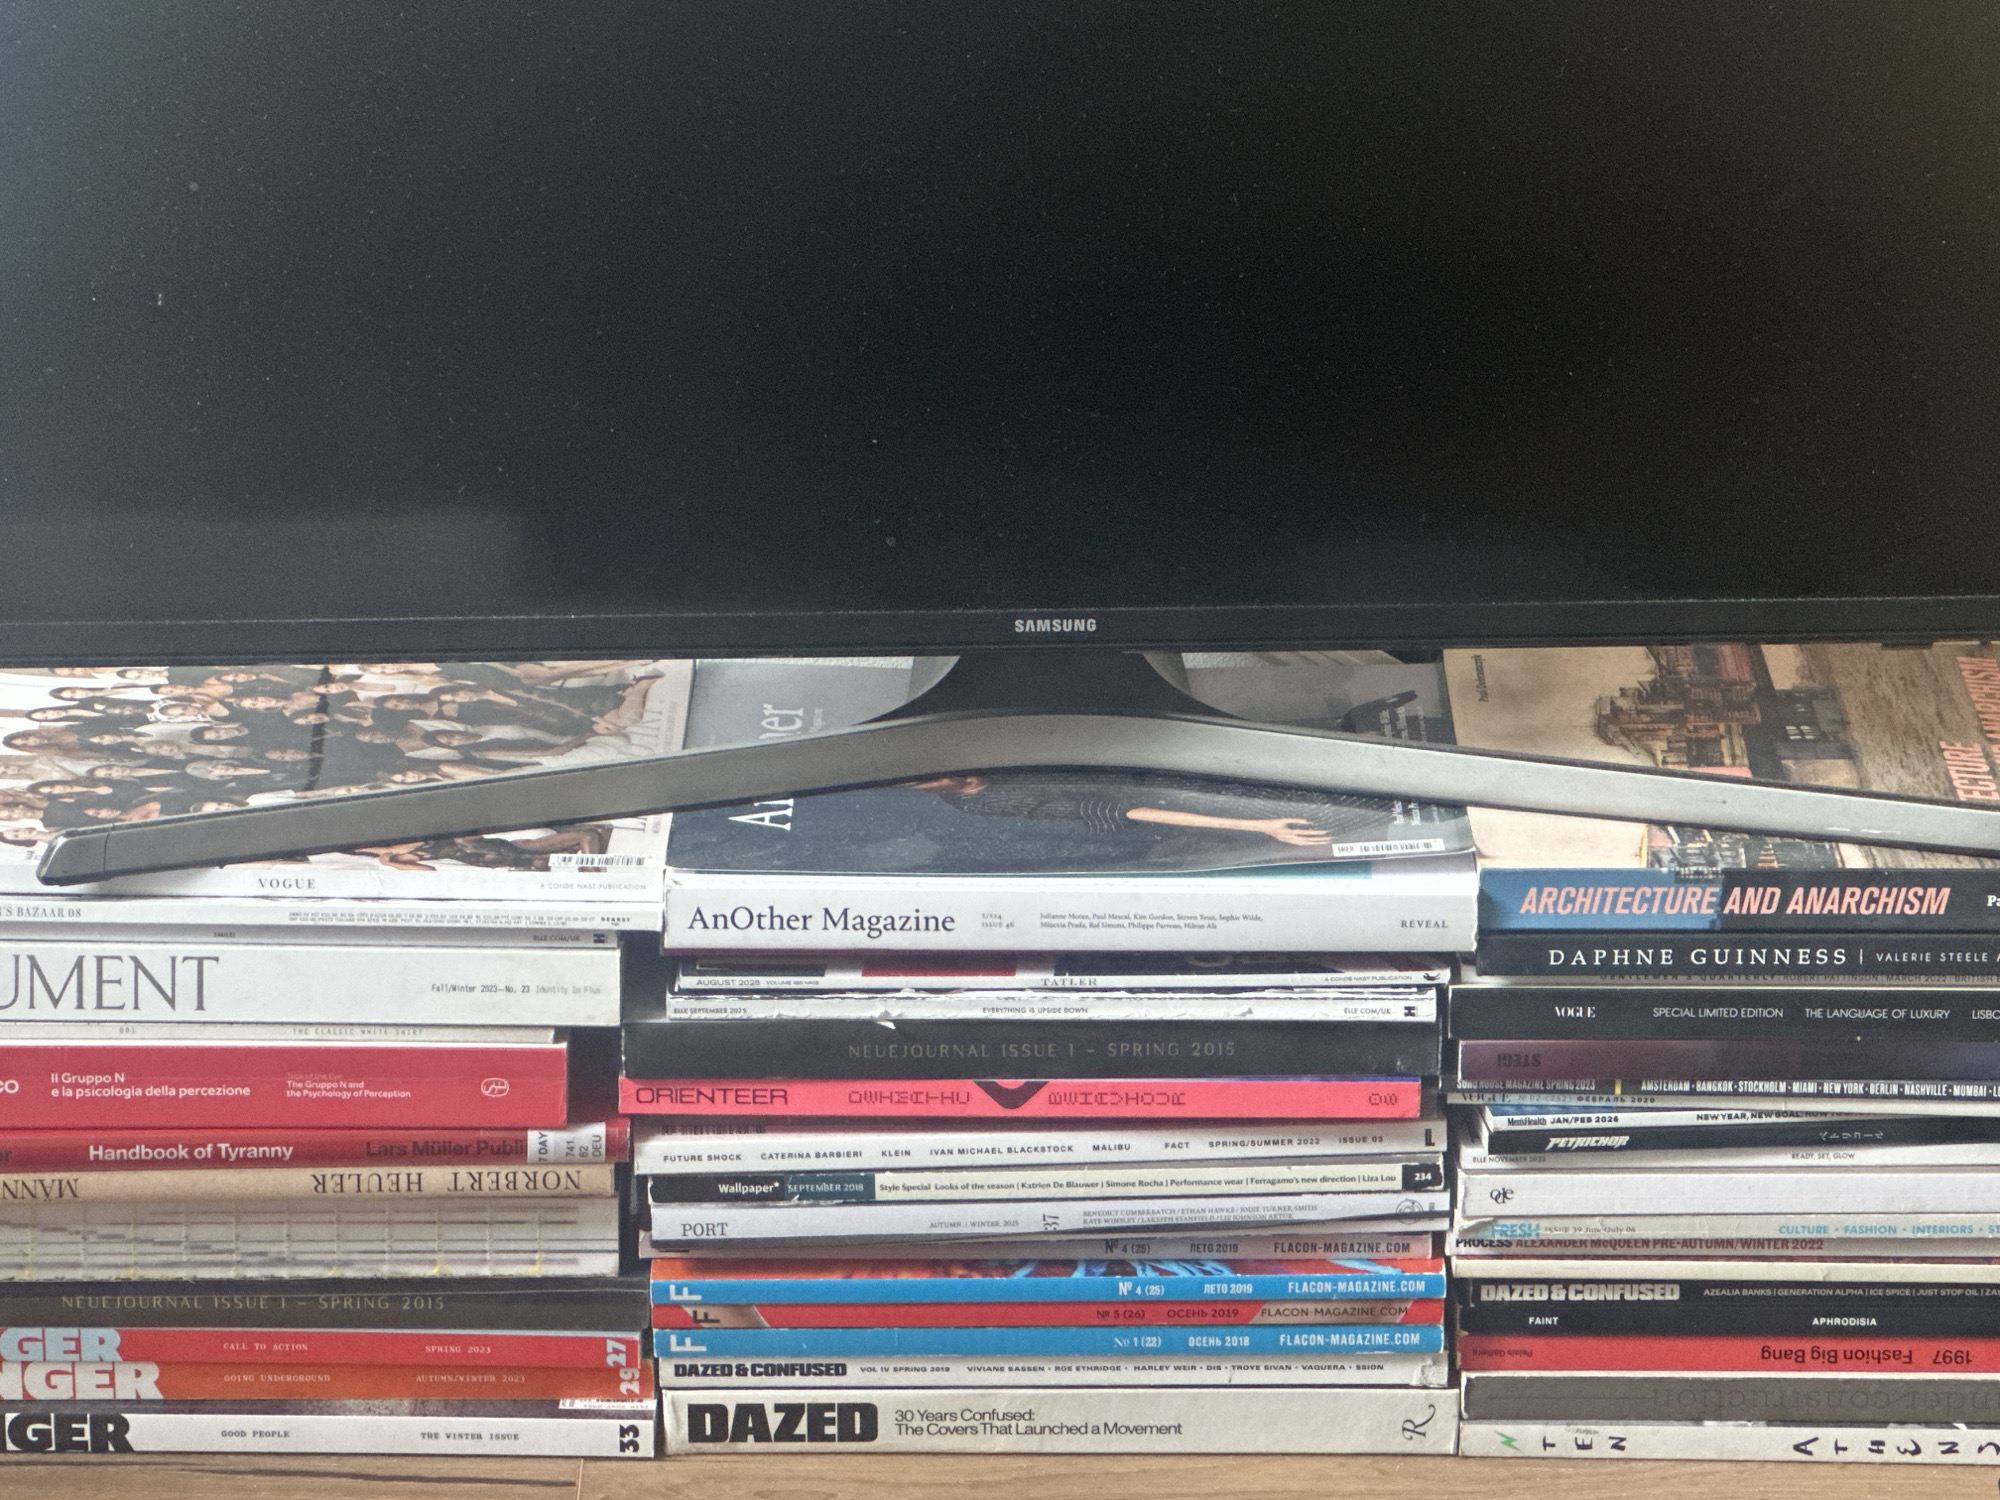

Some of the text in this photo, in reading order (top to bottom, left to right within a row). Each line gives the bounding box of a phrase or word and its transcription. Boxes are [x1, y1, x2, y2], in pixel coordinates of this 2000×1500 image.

[1014, 618, 1097, 633] SAMSUNG
[258, 878, 316, 890] VOGUE
[1519, 886, 1951, 915] ARCHITECTURE AND ANARCHISM
[17, 906, 64, 918] BAZAAR
[688, 905, 956, 939] AnOther Magazine
[1401, 920, 1448, 929] REVEAL
[1548, 949, 1988, 966] DAPHNE GUINNESS VALERIE STEELE
[431, 984, 476, 994] Fall/Winter
[1041, 978, 1098, 986] TATLER
[1554, 1006, 1950, 1019] VOGUE SPECIAL LIMITED EDITION THE LANGUAGE OF LUXURY
[1002, 1042, 1236, 1057] ISSUE SPRING 2015
[61, 1073, 112, 1086] Gruppo
[305, 1080, 364, 1090] Gruppo and
[1575, 1079, 1595, 1090] 2023
[76, 1085, 251, 1099] psicologia della percezione
[303, 1089, 411, 1099] Psychology Perception
[636, 1086, 788, 1105] ORIENTEER
[1641, 1081, 1987, 1097] AMSTERDAM BANGKOK STOCKHOLM MIAMI NEW YORK BERLIN NASHVILLE MUMBAI
[1550, 1115, 1618, 1125] JAN/FEB 2026
[365, 1140, 407, 1157] Lars
[538, 1132, 547, 1155] DAY
[592, 1135, 601, 1158] DEU
[707, 1153, 742, 1162] SHOCK
[760, 1152, 811, 1160] CATERINA
[815, 1151, 862, 1159] BARBIERI
[957, 1147, 1003, 1155] MICHAEL
[1007, 1145, 1074, 1154] BLACKSTOCK
[1209, 1138, 1293, 1148] SPRING/SUMMER
[1545, 1134, 1630, 1151] PETRICHOR
[89, 1143, 293, 1161] Handbook of Tyranny
[579, 1145, 588, 1158] 62
[1472, 1156, 1487, 1164] ELLE
[311, 1170, 582, 1194] NORBERT HEULER
[901, 1175, 1356, 1193] Special Performance direction
[1414, 1173, 1432, 1181] 234
[788, 1183, 841, 1193] SEPTEMBER
[681, 1221, 962, 1237] PORT AUTUMN
[1491, 1222, 1974, 1237] FRESH CULTURE FASHION INTERIORS
[1214, 1242, 1411, 1254] 2019 FLACON-MAGAZINE.COM
[1653, 1238, 1824, 1250] PRE-AUTUMN/WINTER 2022
[669, 1284, 702, 1301] F
[1145, 1280, 1425, 1297] (25) ЛЕТО 2019 FLACON-MAGAZINE.COM
[1480, 1283, 1680, 1301] DAZED & CONFUSED
[1703, 1288, 1864, 1296] AZEALIA BANKS GENERATION ALPHA
[214, 1296, 444, 1311] ISSUE SPRING 2015
[692, 1309, 720, 1324] F
[1167, 1308, 1239, 1319] ОСЕНЬ 2019
[1528, 1316, 1877, 1326] FAINT APHRODISIA
[273, 1343, 308, 1351] ACTION
[669, 1333, 707, 1352] F
[1188, 1333, 1420, 1347] ОСЕНЬ 2018 FLACON-MAGAZINE.COM
[606, 1339, 627, 1367] 27
[1760, 1345, 1972, 1365] 1997 Fashion Big Bang
[674, 1362, 847, 1377] DAZED CONFUSED
[224, 1374, 331, 1382] GOING UNDERGROUND
[619, 1367, 640, 1395] 29
[687, 1402, 878, 1443] DAZED
[895, 1408, 1035, 1422] 30 Years Confused:
[221, 1430, 246, 1438] GOOD
[252, 1430, 290, 1438] PEOPLE
[894, 1422, 1182, 1436] The Covers That Launched Movement
[619, 1424, 640, 1453] 33
